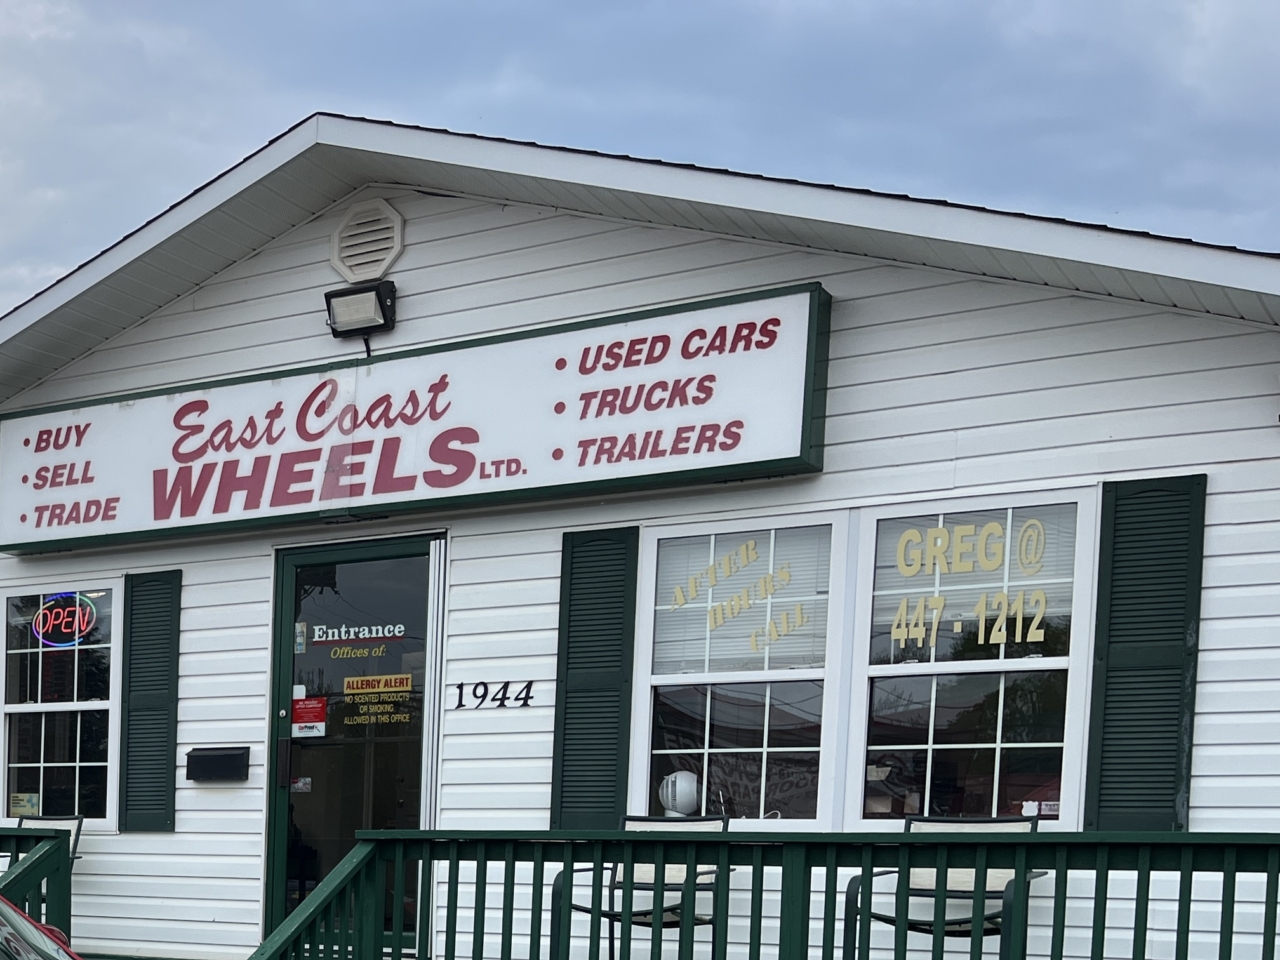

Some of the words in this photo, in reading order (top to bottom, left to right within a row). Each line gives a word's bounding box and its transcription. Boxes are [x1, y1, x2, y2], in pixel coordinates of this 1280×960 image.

[578, 334, 671, 375] USED
[680, 317, 781, 360] CARS
[578, 374, 717, 420] TRUCKS
[172, 399, 286, 464] East
[296, 374, 452, 442] Coast
[34, 422, 92, 453] BUY
[577, 420, 744, 467] TRAILERS
[33, 460, 95, 490] SELL
[153, 426, 480, 521] WHEELS
[479, 458, 528, 480] LTD.
[34, 497, 121, 528] TRADE
[896, 522, 1005, 577] GREG
[1017, 518, 1046, 576] @
[670, 539, 760, 612] AFTER
[708, 561, 792, 632] HOURS
[36, 606, 91, 634] OPEN
[312, 623, 406, 642] Entrance
[749, 603, 810, 653] CALL
[891, 596, 946, 649] 447
[974, 589, 1047, 645] 1212
[330, 646, 369, 659] Offices
[371, 644, 387, 657] of:
[344, 695, 353, 704] NO
[354, 694, 379, 704] SCENTED
[380, 692, 410, 702] PRODUCTS
[346, 679, 382, 691] ALLERGY
[383, 677, 410, 688] ALERT
[455, 680, 534, 709] 1944
[344, 715, 369, 725] ALLOWED
[370, 715, 376, 724] IN
[377, 715, 390, 723] THIS
[391, 713, 410, 723] OFFICE
[359, 705, 368, 713] OR
[369, 704, 394, 713] SMOKING
